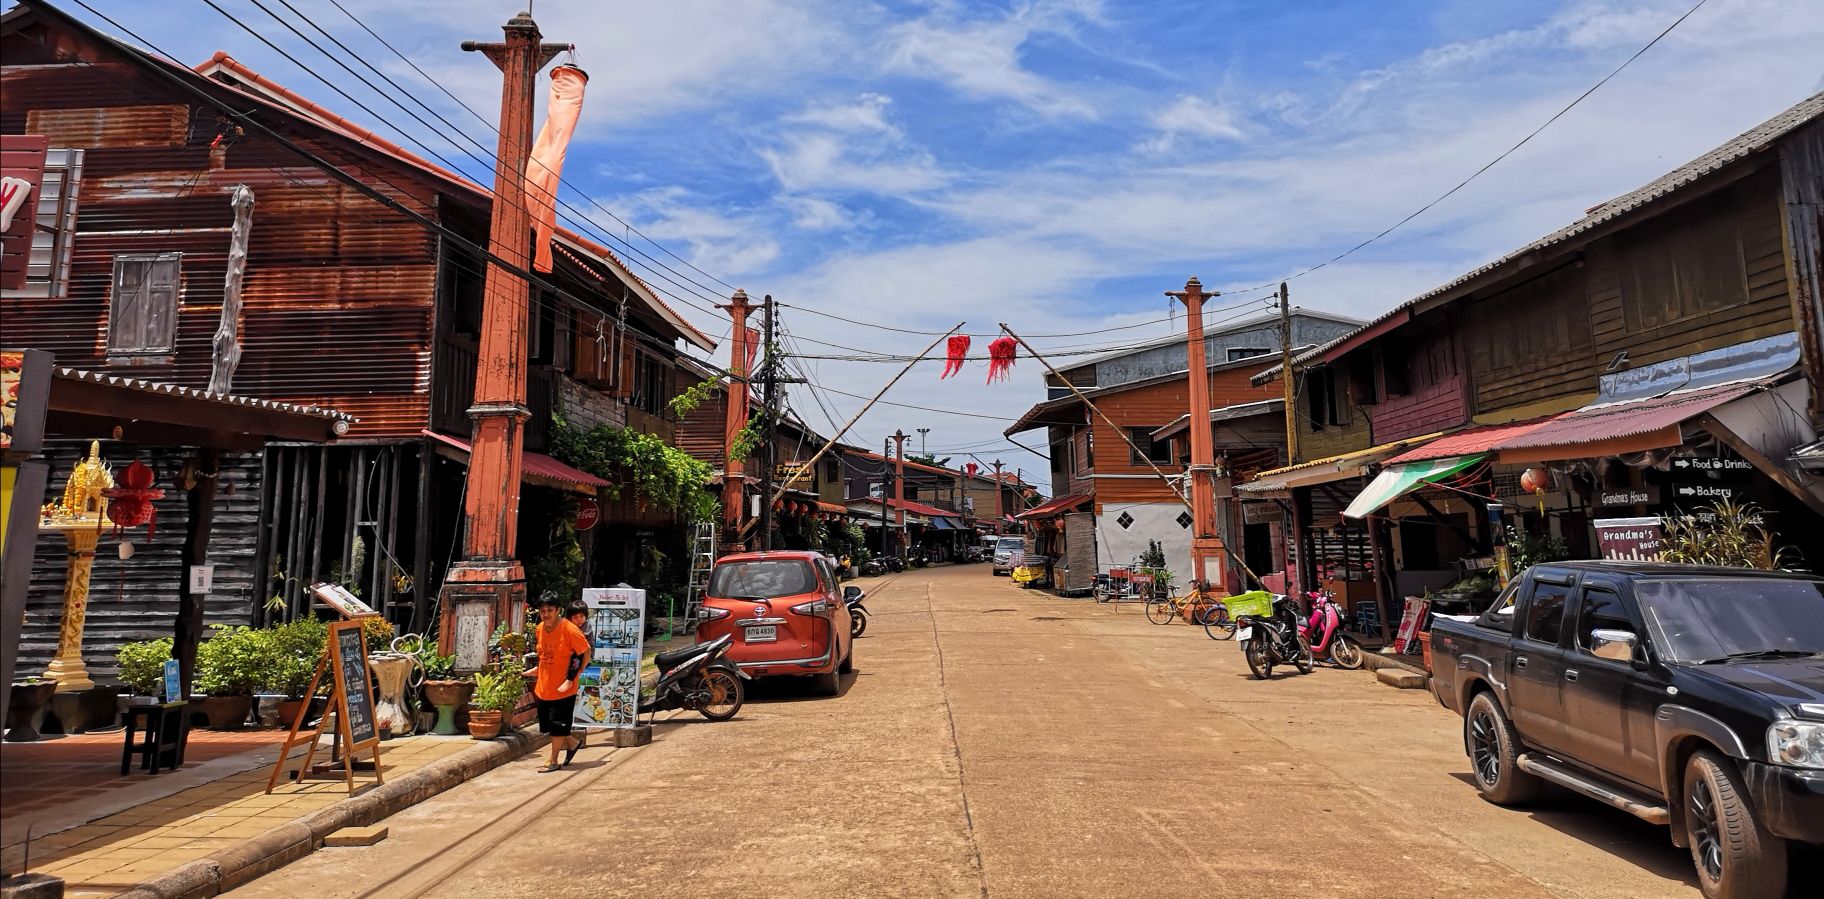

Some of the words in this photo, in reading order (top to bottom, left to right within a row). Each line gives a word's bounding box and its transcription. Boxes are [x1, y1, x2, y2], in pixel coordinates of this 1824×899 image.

[1692, 458, 1712, 469] Food
[1724, 459, 1753, 470] Drinks
[773, 474, 812, 482] Restarant
[1629, 490, 1649, 505] House
[1696, 485, 1732, 498] Bakery
[1603, 529, 1653, 541] Grandma's
